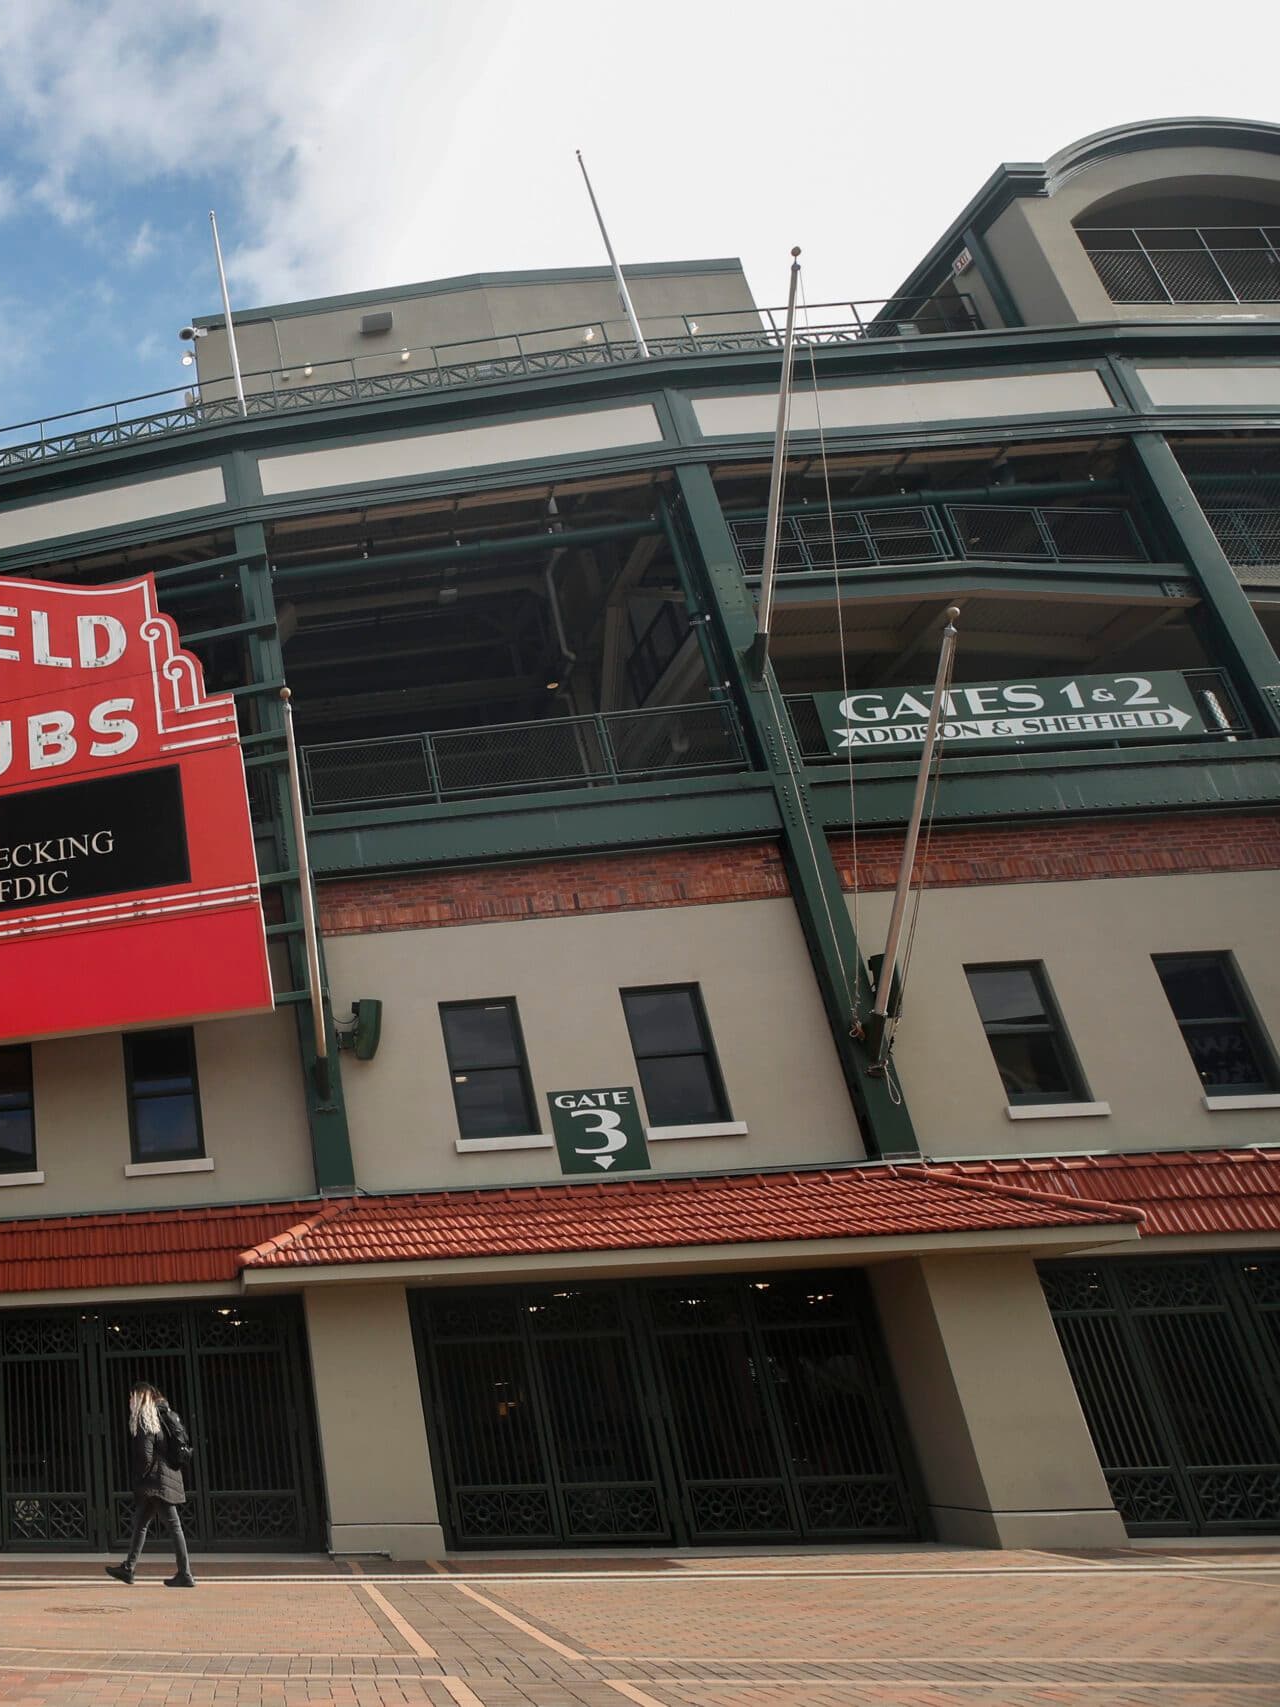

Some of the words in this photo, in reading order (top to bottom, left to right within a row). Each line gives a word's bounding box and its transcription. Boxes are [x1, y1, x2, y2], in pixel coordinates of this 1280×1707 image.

[839, 684, 1044, 722] GATES
[992, 720, 1012, 736] &
[1022, 711, 1174, 734] SHEFFIELD
[554, 1091, 630, 1109] GATE
[570, 1109, 628, 1154] 3
